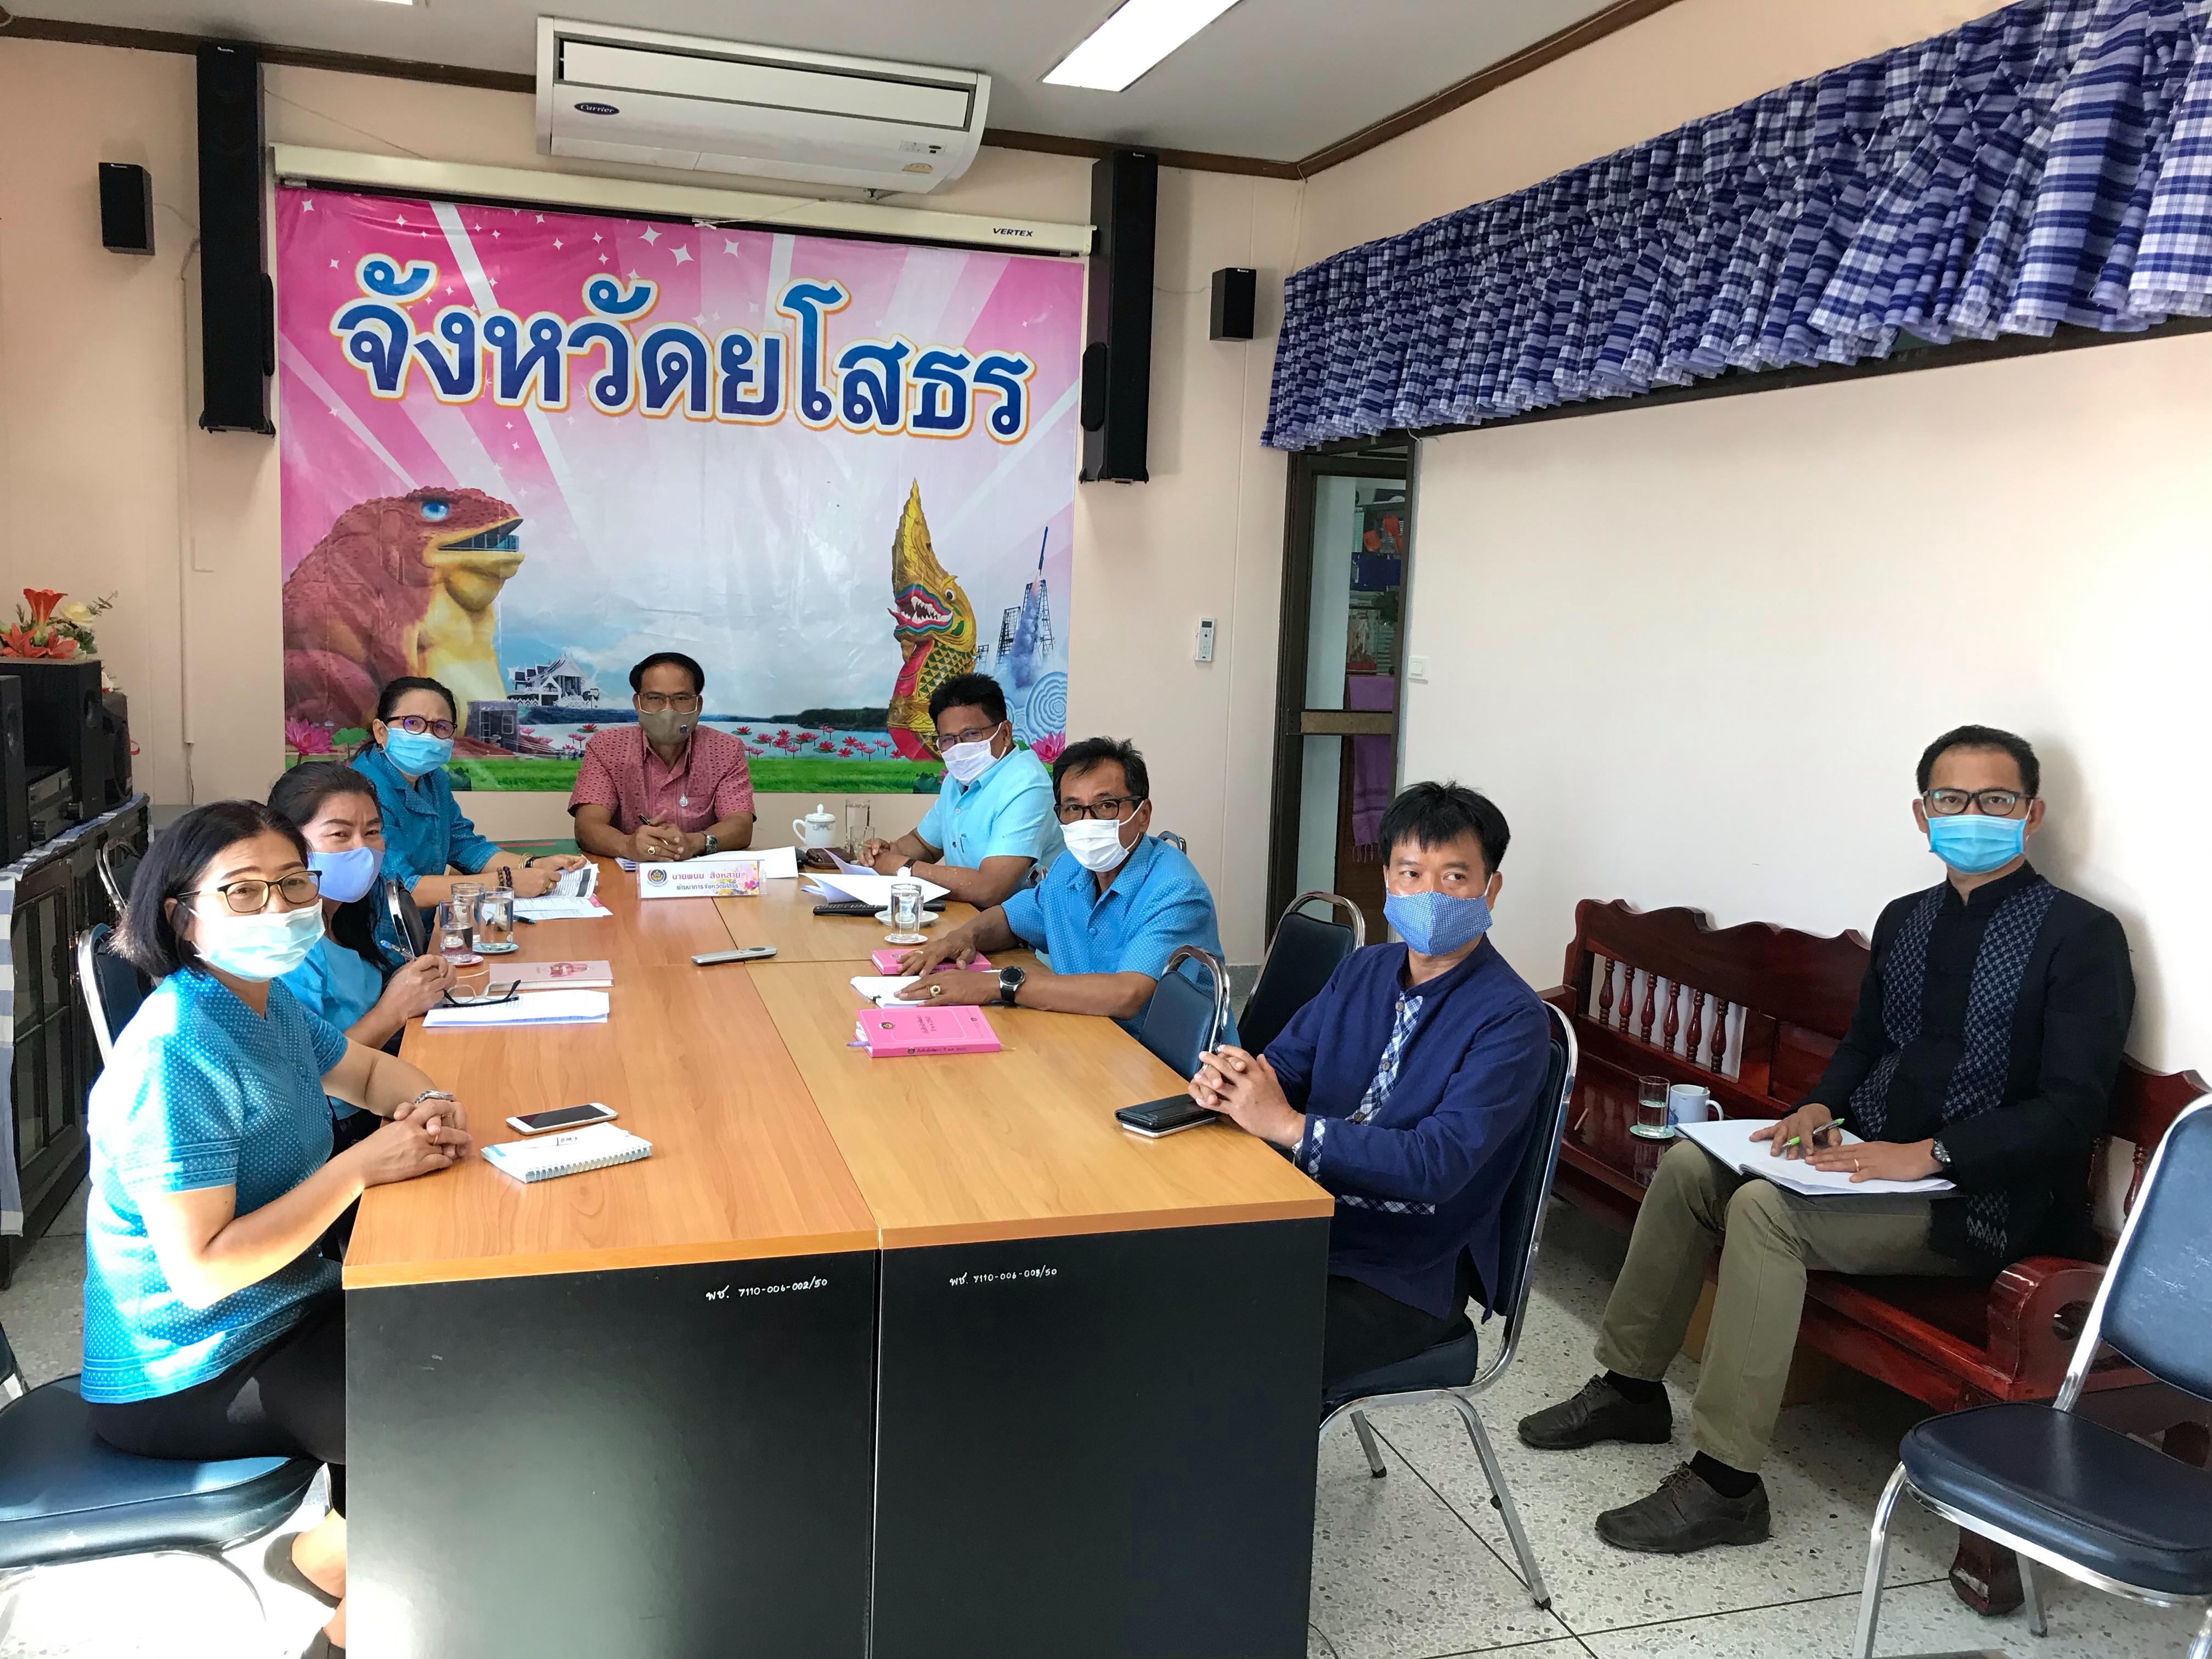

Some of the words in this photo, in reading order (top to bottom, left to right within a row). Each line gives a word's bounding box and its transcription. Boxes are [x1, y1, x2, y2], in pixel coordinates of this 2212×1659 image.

[580, 104, 614, 113] Carrier
[993, 228, 1033, 237] VERTEX
[334, 255, 1032, 441] จังหวัดยโสธร
[950, 1272, 968, 1286] พช.
[706, 1284, 730, 1301] พช.
[738, 1276, 828, 1297] 7110-006-002/50
